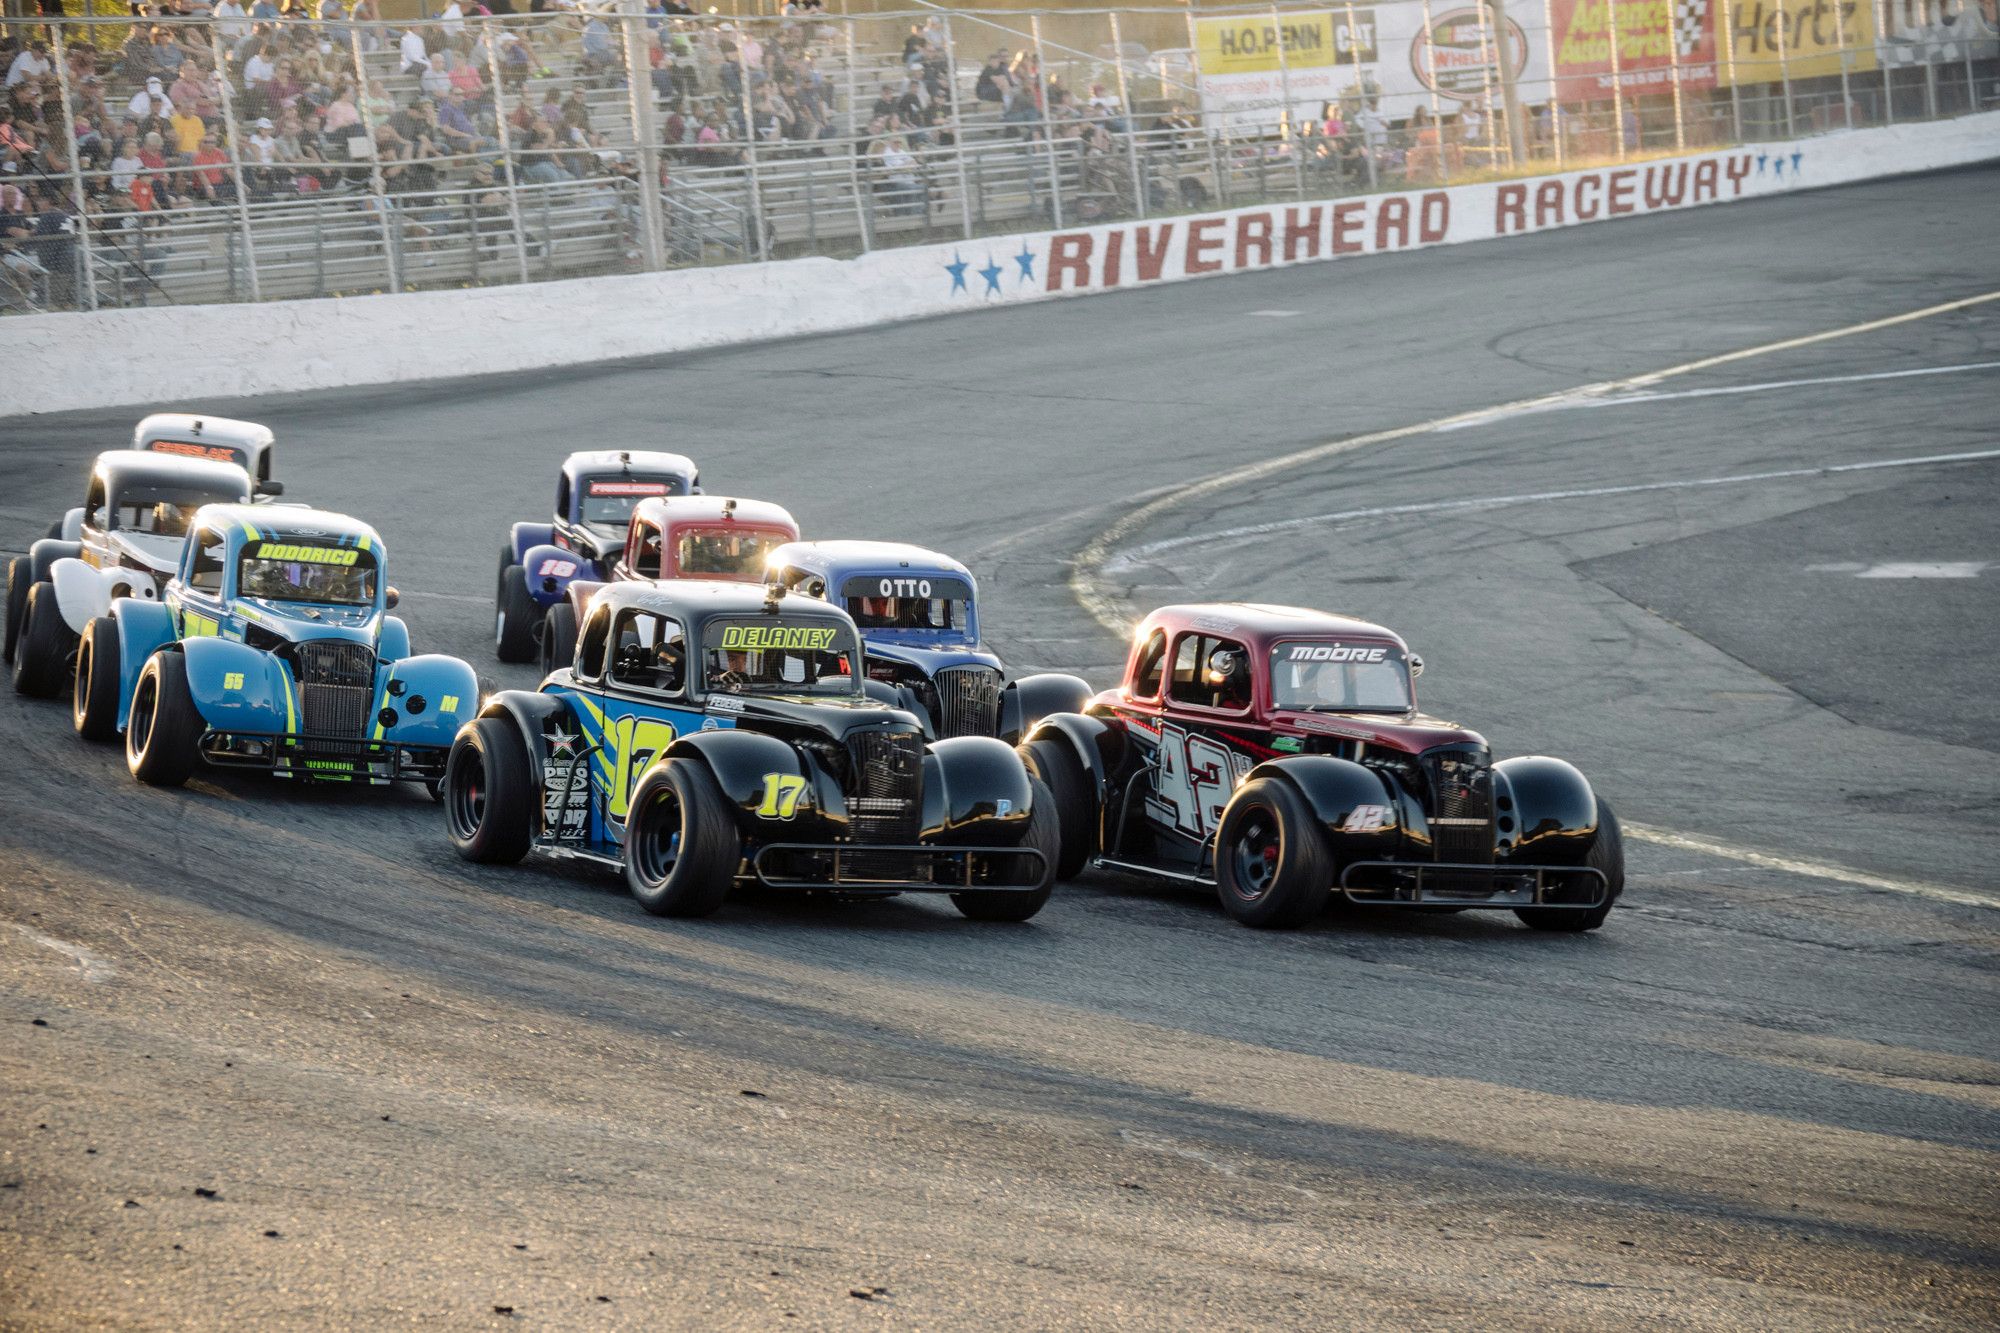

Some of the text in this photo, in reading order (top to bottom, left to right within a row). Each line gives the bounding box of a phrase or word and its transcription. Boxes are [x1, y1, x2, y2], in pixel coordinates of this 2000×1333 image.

[1336, 23, 1374, 53] CAT
[1732, 0, 1855, 53] Hertz
[1558, 35, 1611, 65] Auto
[1598, 72, 1635, 88] Seice
[1666, 67, 1689, 81] bst
[1046, 154, 1752, 291] RIVERHEAD RACEWAY
[256, 543, 359, 566] DODORICO
[880, 578, 931, 598] OTTO
[722, 627, 837, 649] DELANEY
[1288, 646, 1387, 663] MOORE
[224, 672, 244, 690] 55
[608, 714, 679, 825] 17
[1157, 720, 1238, 842] 42
[755, 772, 810, 821] 17
[1343, 804, 1385, 833] 42
